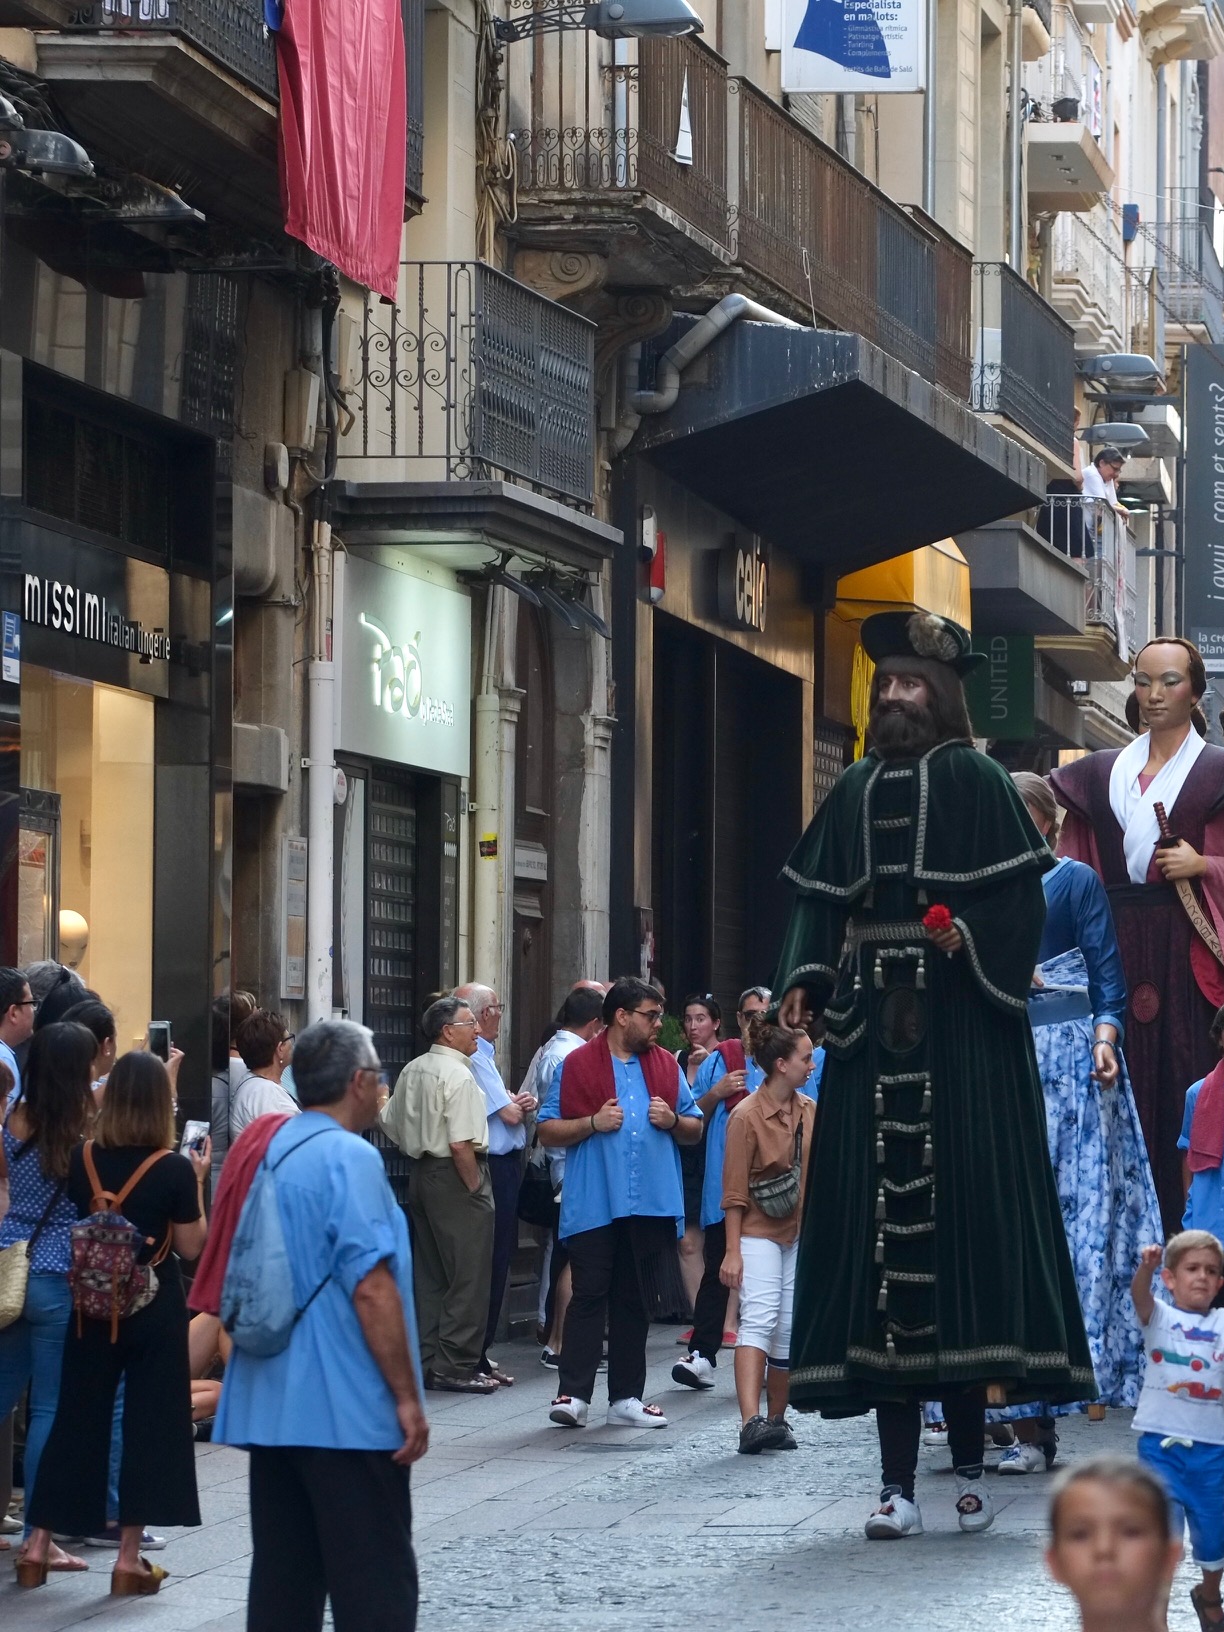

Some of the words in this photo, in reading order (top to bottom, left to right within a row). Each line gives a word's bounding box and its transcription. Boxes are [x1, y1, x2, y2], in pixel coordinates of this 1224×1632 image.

[844, 0, 901, 11] Especialista
[844, 13, 856, 21] en
[858, 11, 898, 21] mallots:
[736, 533, 767, 632] celio
[1199, 632, 1208, 642] la
[990, 635, 1008, 719] UNITED
